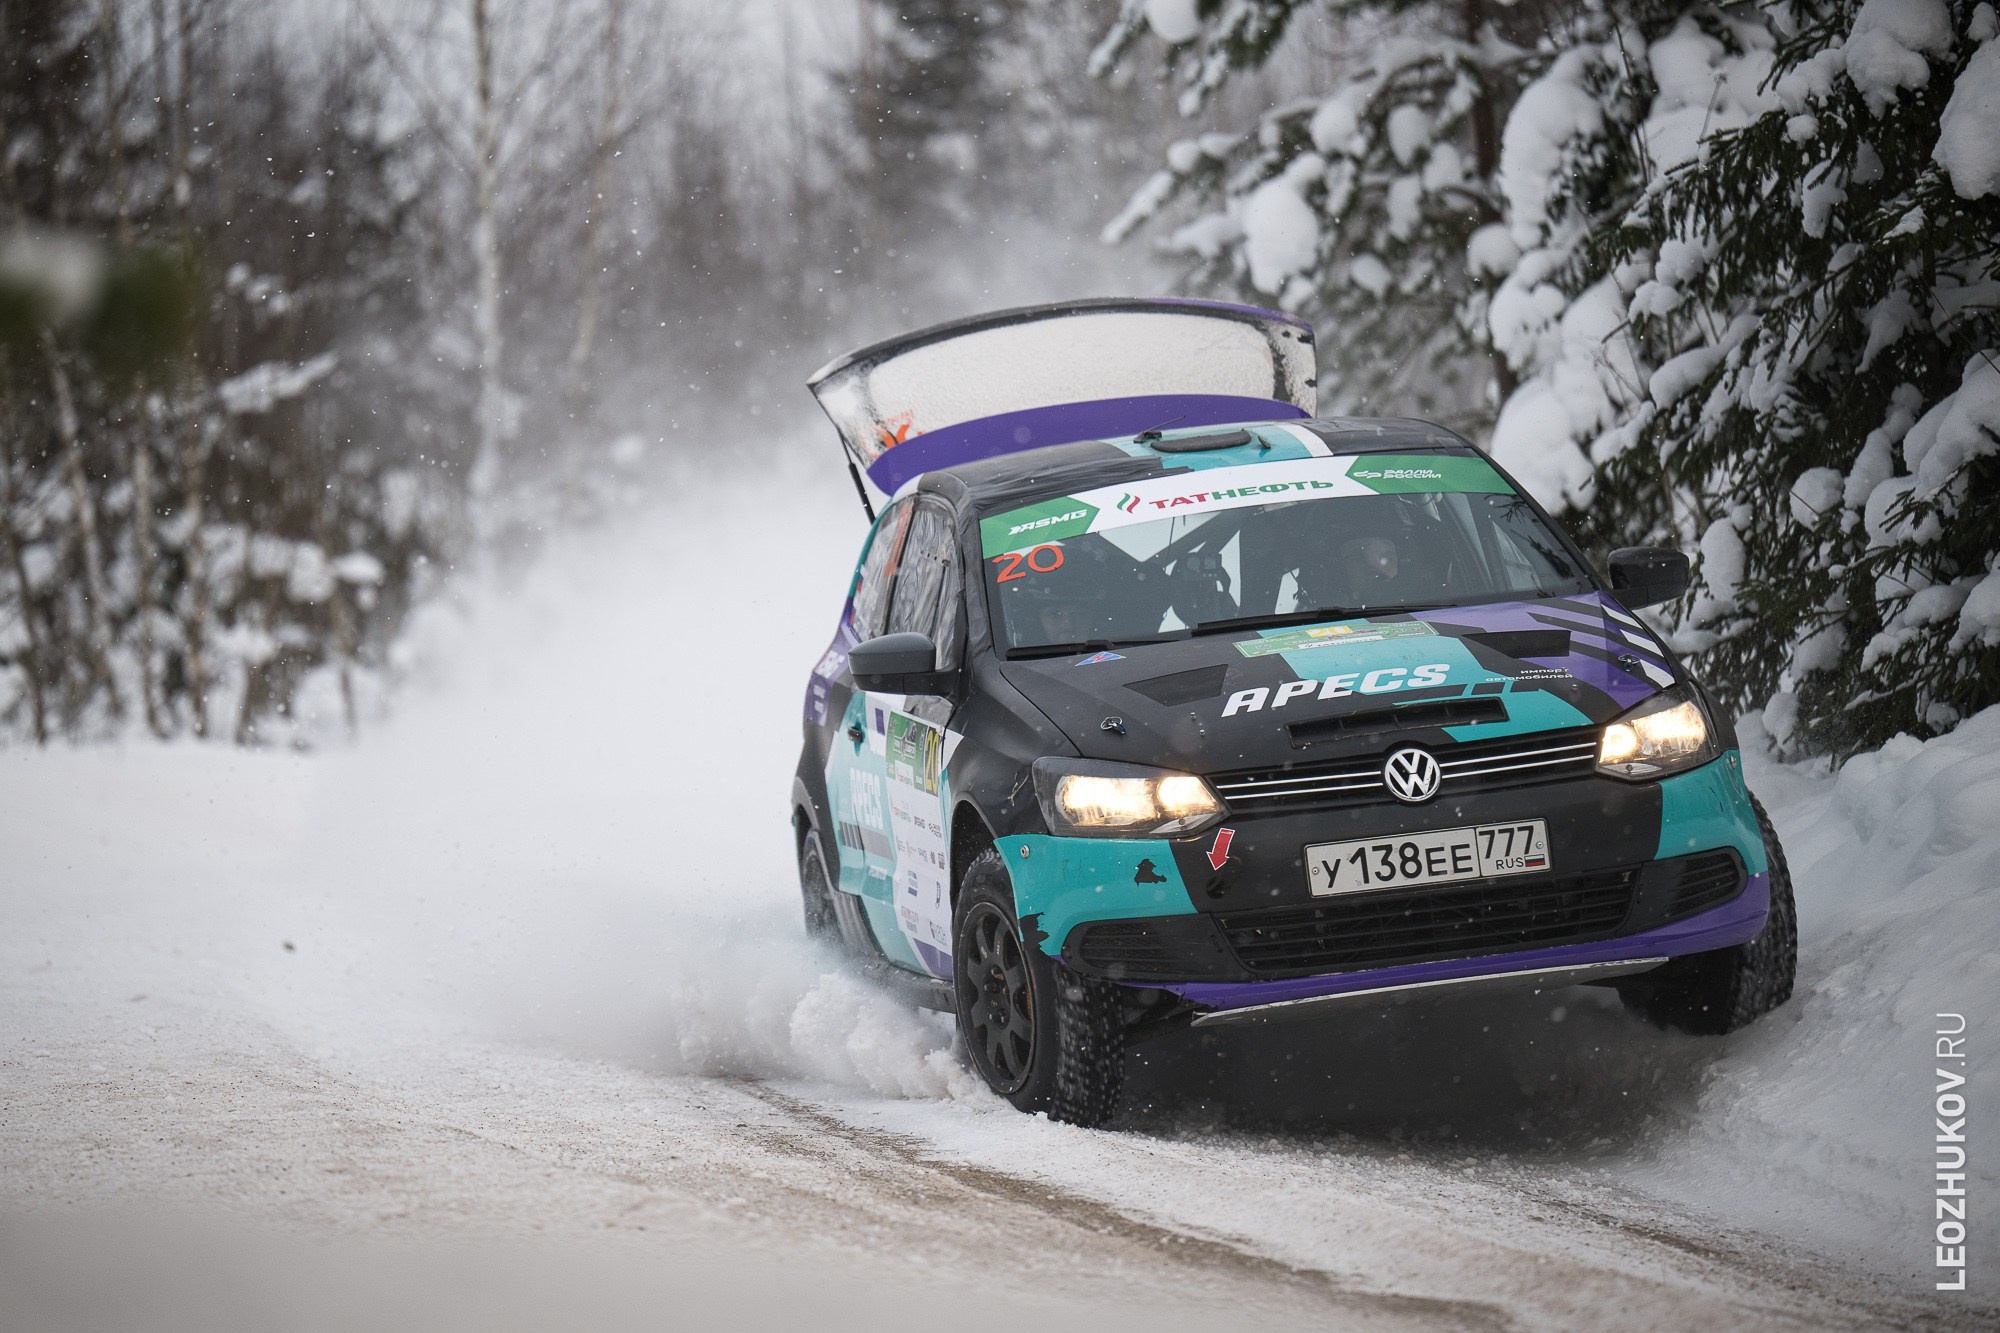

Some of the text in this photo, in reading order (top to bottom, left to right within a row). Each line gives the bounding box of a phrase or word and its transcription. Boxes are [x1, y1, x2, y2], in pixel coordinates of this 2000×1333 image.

[1149, 480, 1334, 510] ТАТНЕФТЬ
[992, 544, 1064, 583] 20
[1306, 625, 1352, 639] 20
[1221, 663, 1451, 718] APECS
[1485, 673, 1573, 682] автомобилей
[925, 730, 940, 795] 20
[1478, 825, 1535, 859] 777
[1495, 857, 1524, 870] RUS
